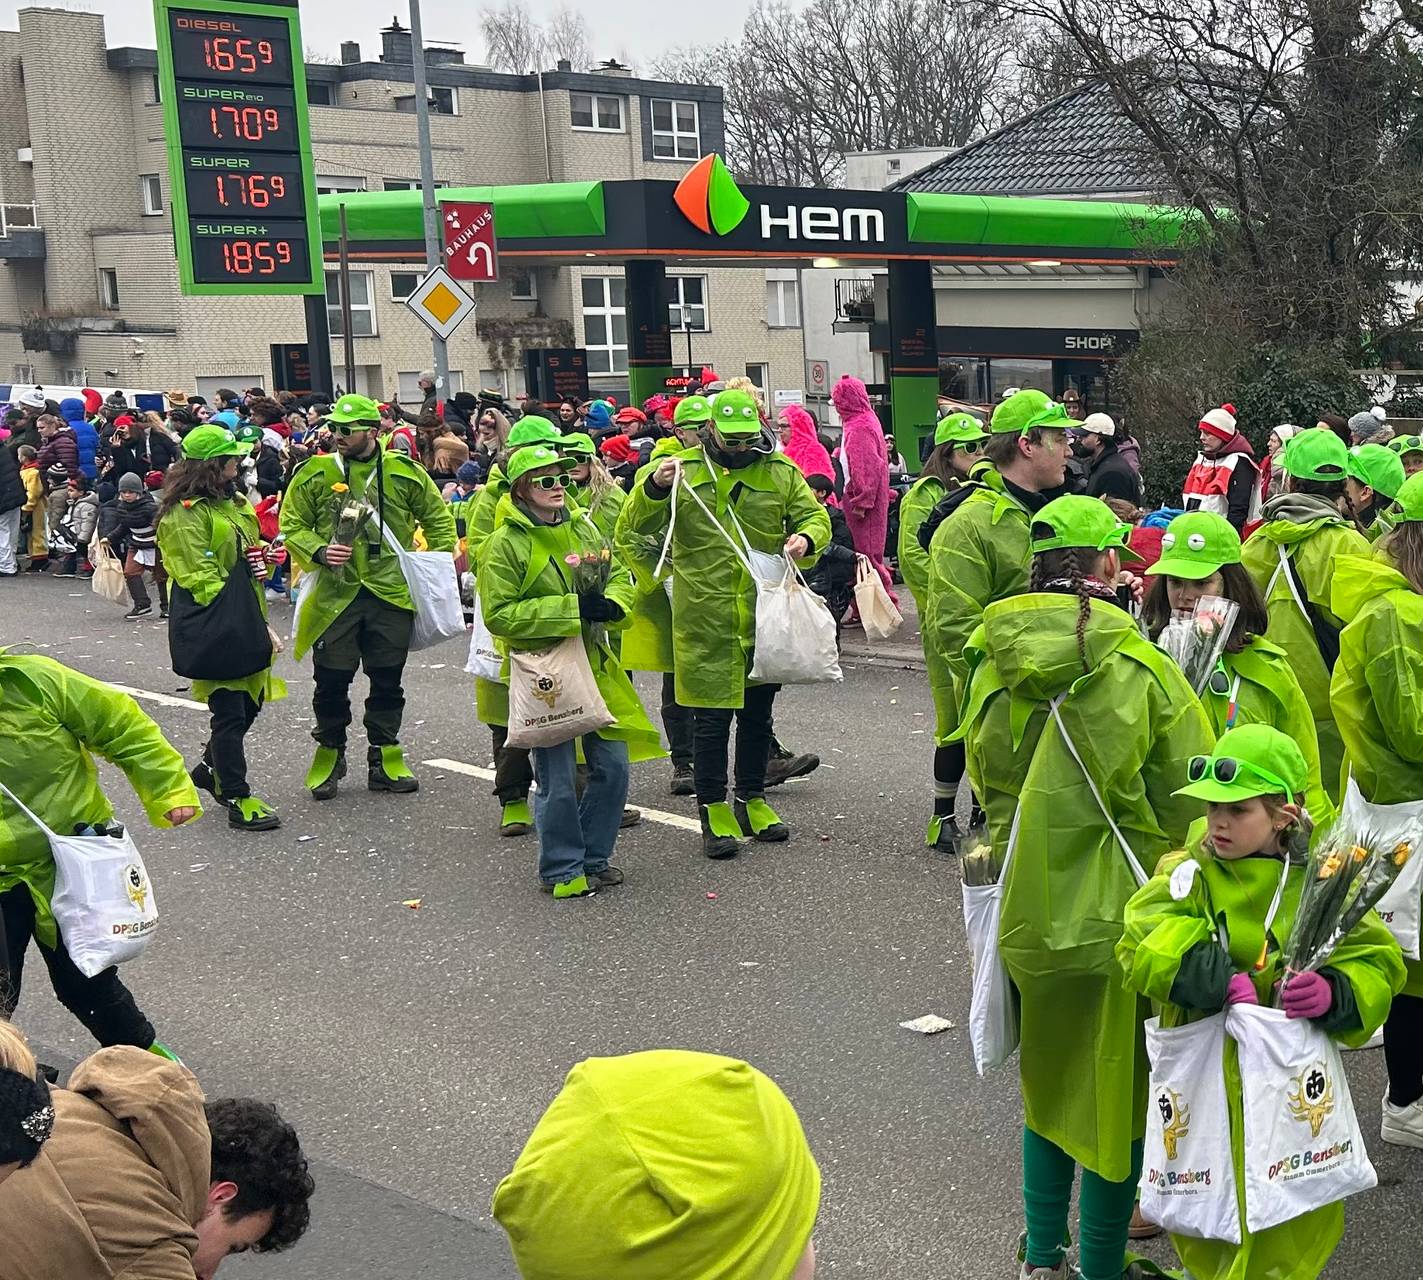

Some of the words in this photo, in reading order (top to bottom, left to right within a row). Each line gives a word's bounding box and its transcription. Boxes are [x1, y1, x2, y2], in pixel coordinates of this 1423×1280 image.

[446, 209, 492, 257] BAUHAUS
[1065, 336, 1112, 349] SHOP
[525, 715, 547, 727] DPSG
[548, 706, 584, 721] Bensberg
[112, 923, 139, 934] DPSG
[1268, 1154, 1300, 1180] DPSG
[1167, 1168, 1212, 1186] Bensberg
